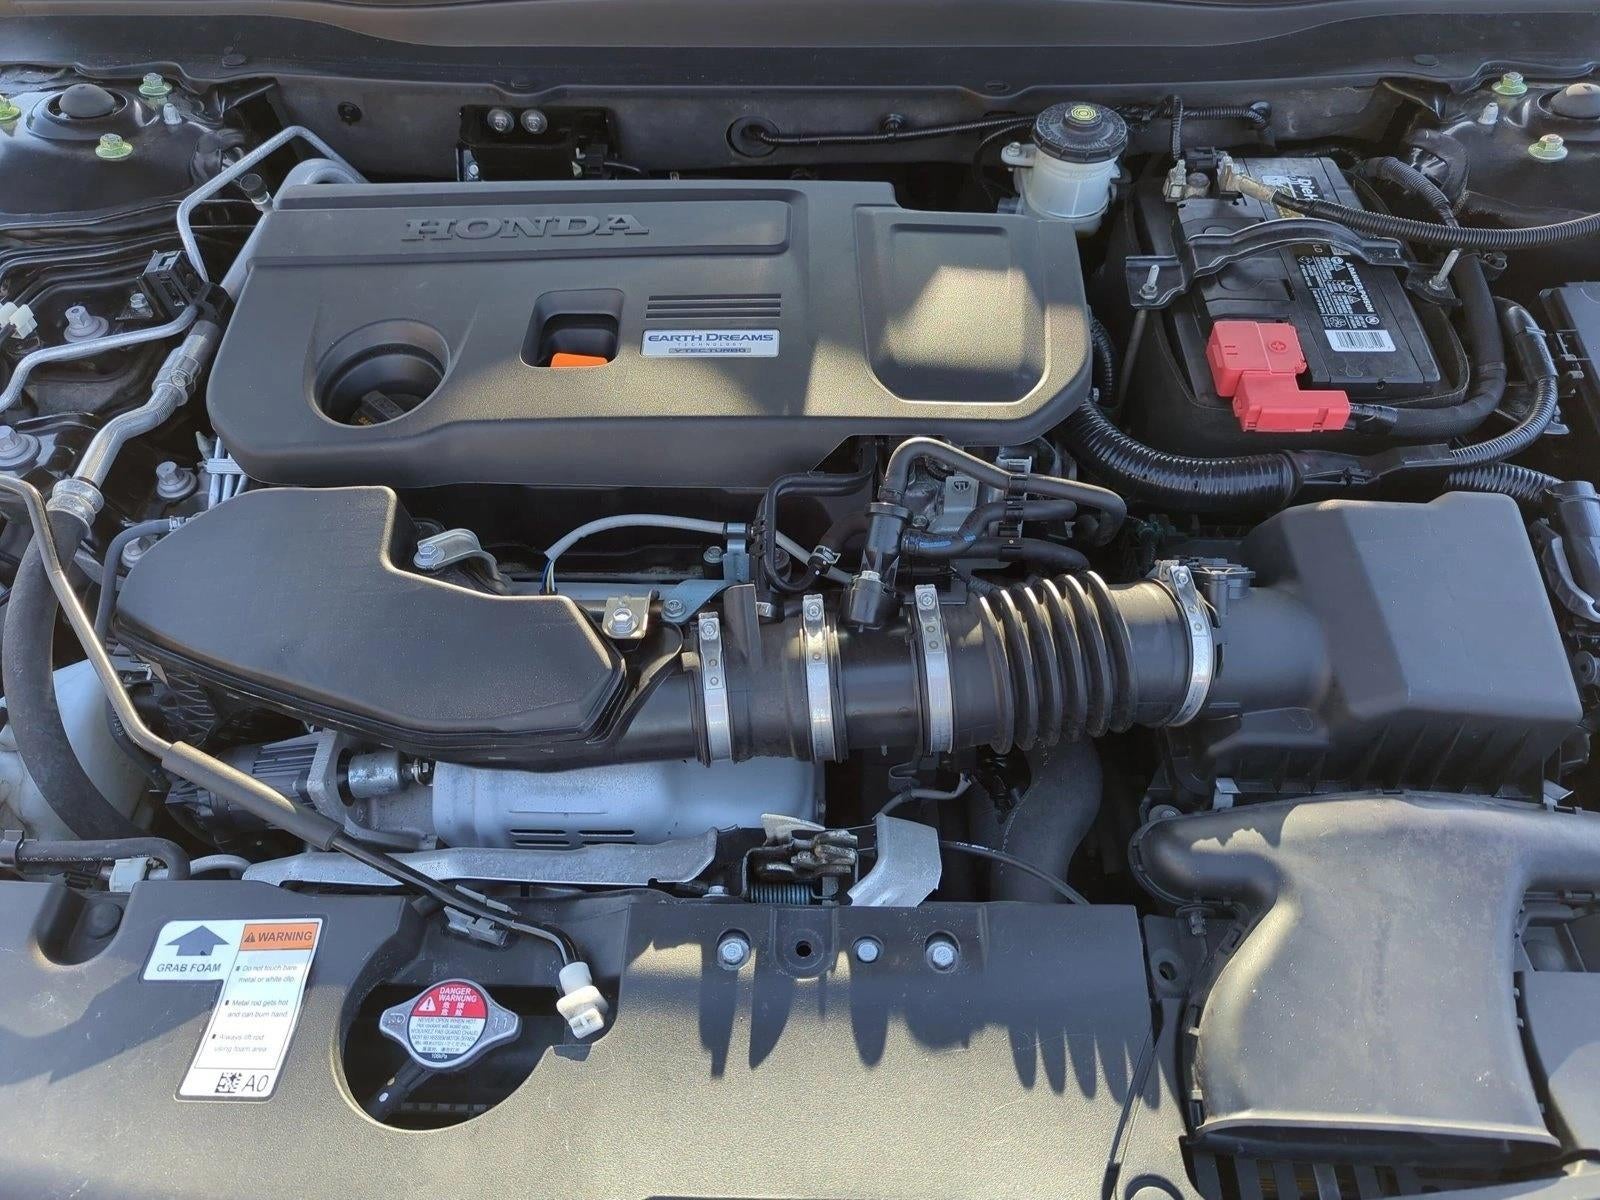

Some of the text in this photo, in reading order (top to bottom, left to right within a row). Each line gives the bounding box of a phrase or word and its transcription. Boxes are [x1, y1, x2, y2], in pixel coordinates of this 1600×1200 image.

[401, 214, 649, 242] HONDA
[648, 333, 774, 342] EARTH DREAMS
[257, 931, 313, 942] WARNING
[156, 963, 222, 973] GRAB FOAM
[440, 986, 471, 995] DANGER
[438, 994, 477, 1003] WARNUNG
[262, 1000, 277, 1008] gets
